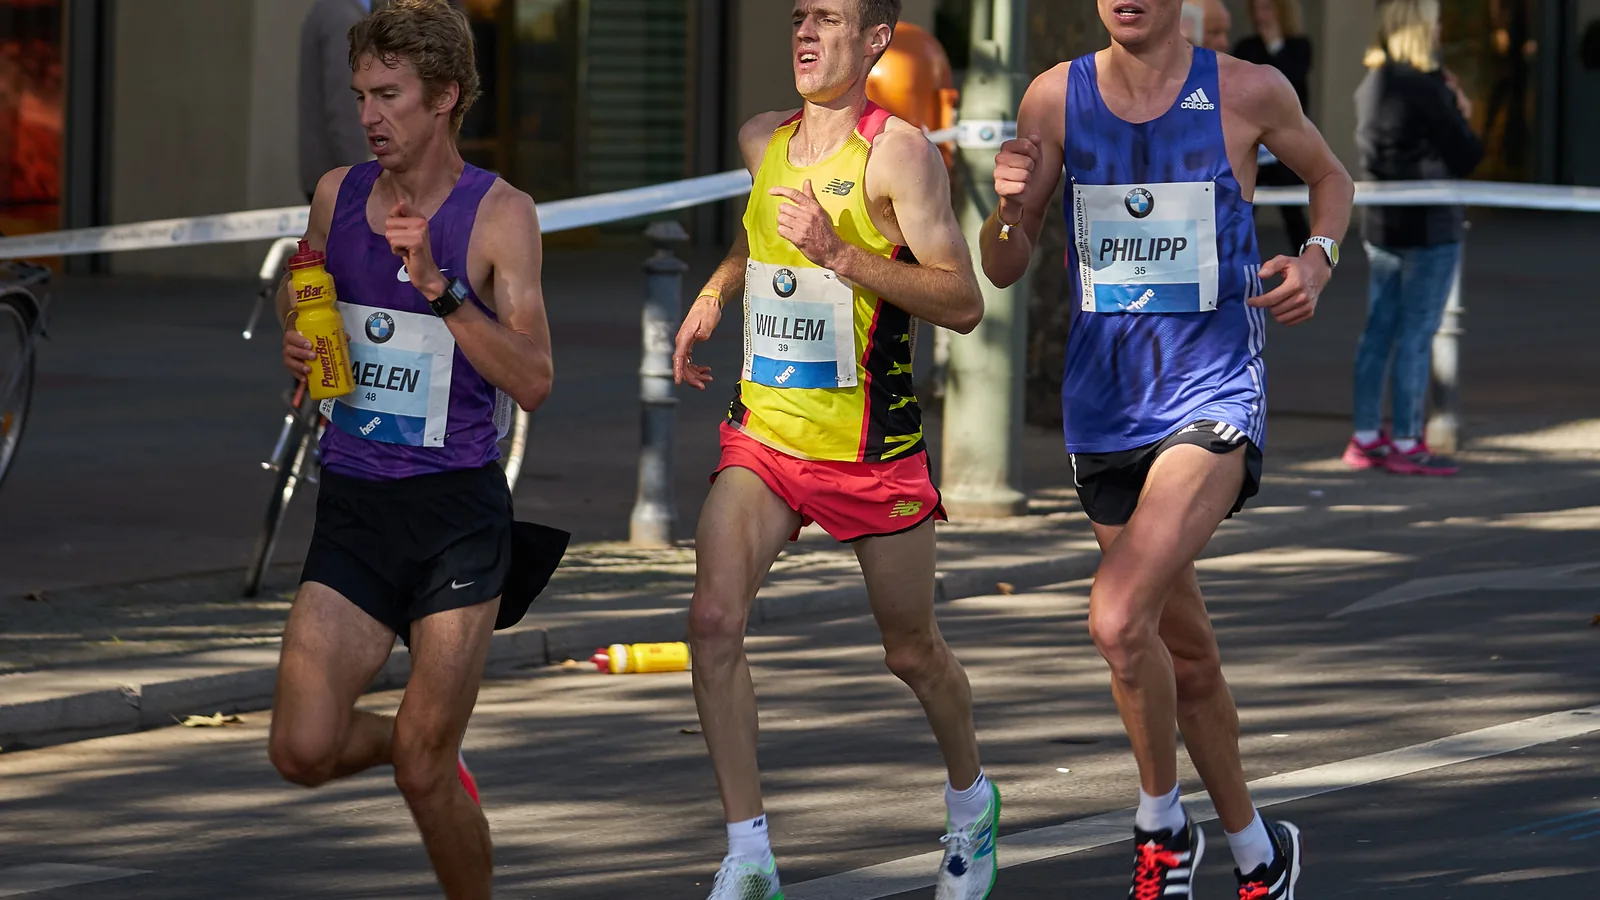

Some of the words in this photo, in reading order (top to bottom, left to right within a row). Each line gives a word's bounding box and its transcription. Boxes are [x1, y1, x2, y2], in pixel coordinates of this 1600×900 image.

[1180, 101, 1215, 110] adidas
[1100, 237, 1187, 262] PHILIPP
[1134, 266, 1146, 275] 35
[1130, 288, 1155, 310] here
[755, 312, 826, 341] WILLEM
[778, 343, 789, 352] 39
[315, 335, 335, 388] PowerBar
[774, 365, 796, 384] here
[365, 392, 377, 401] 48
[359, 416, 382, 436] here
